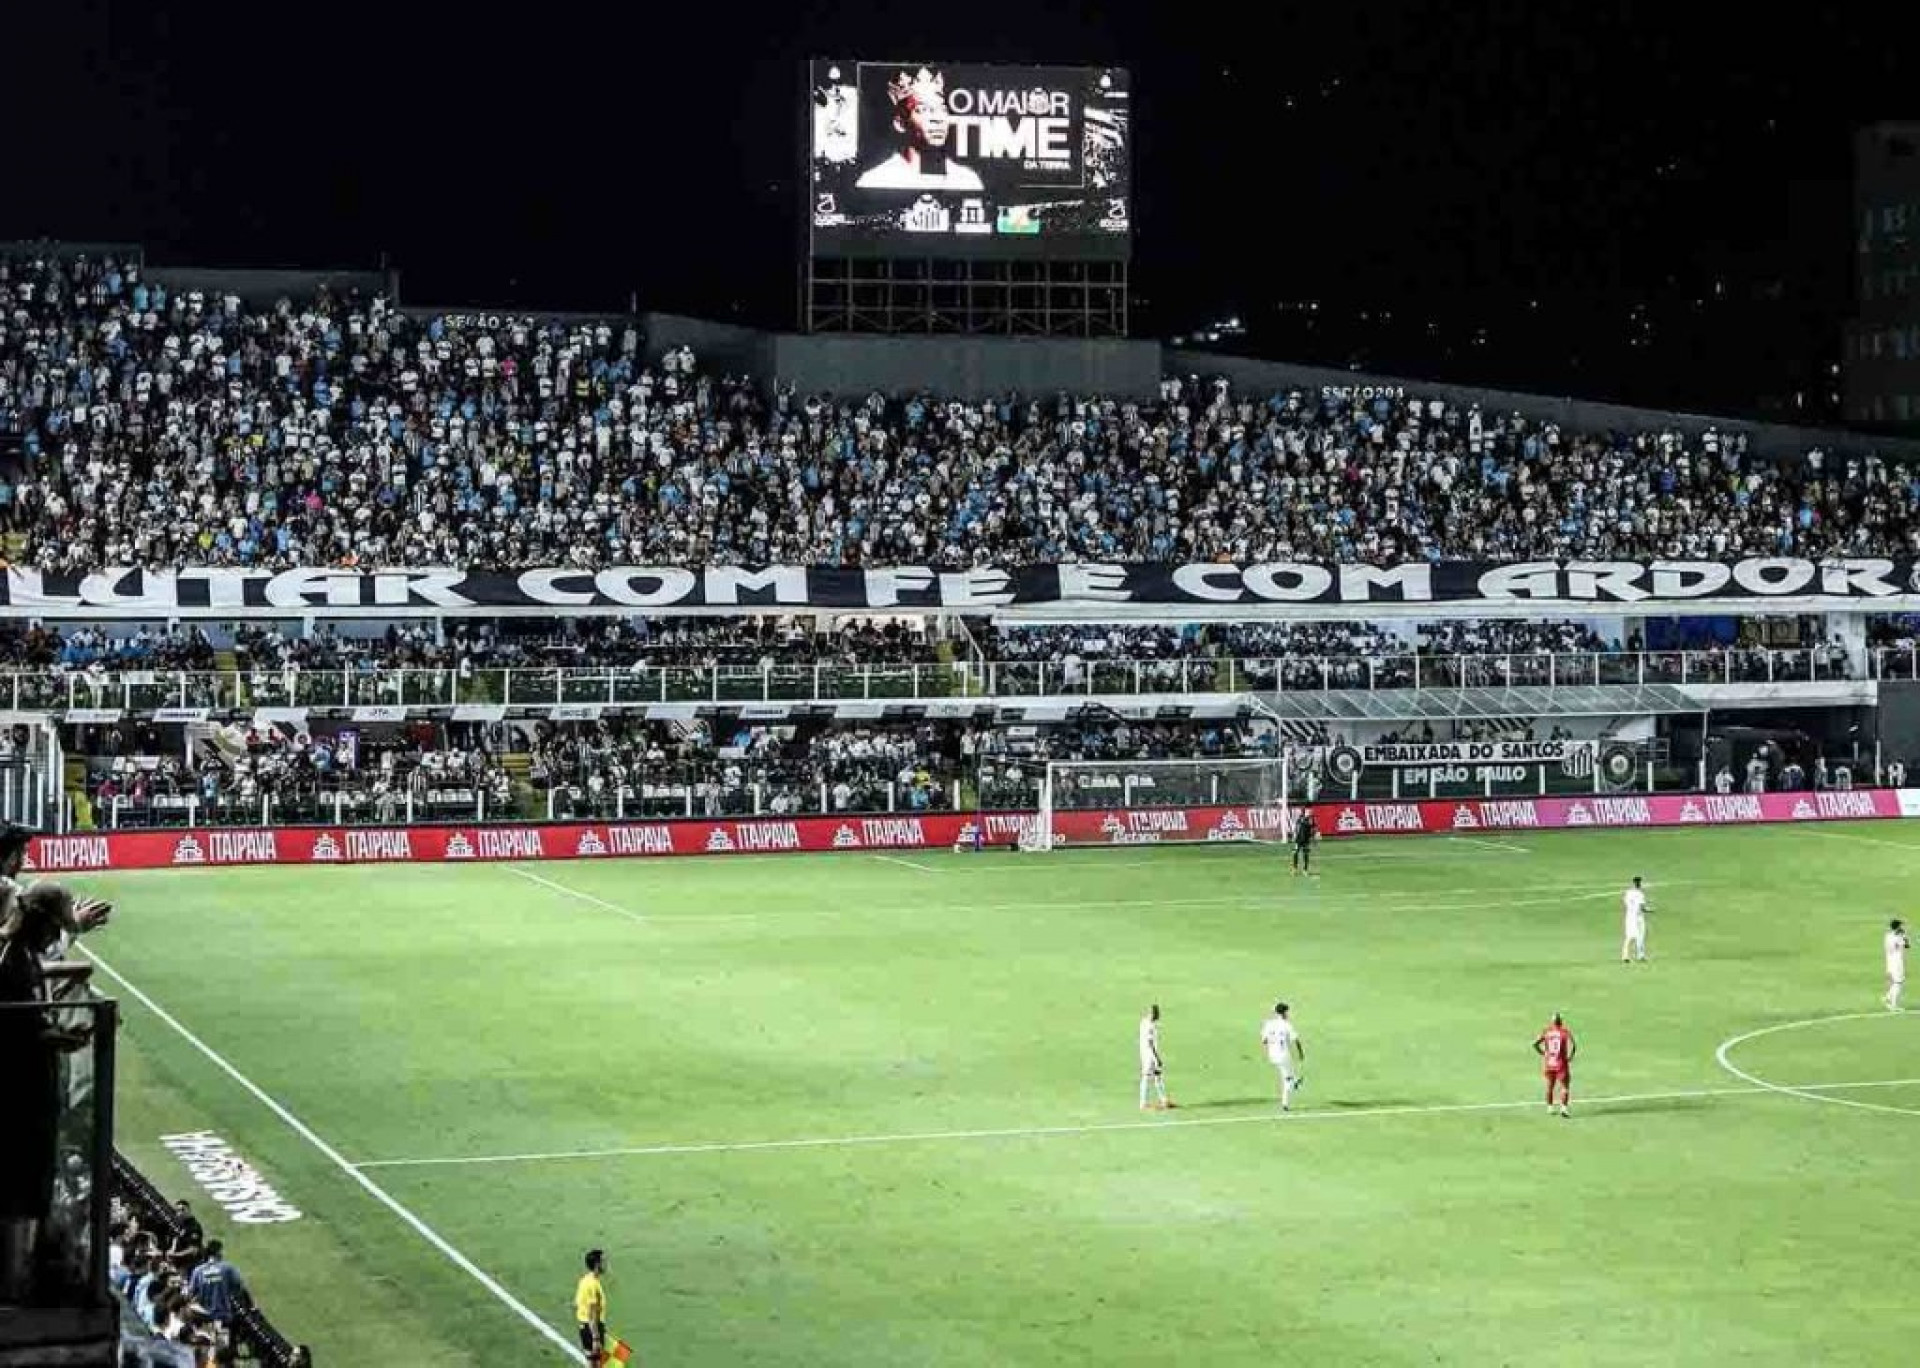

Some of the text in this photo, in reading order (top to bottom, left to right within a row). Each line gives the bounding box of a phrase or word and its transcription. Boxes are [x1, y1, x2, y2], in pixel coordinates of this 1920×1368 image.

[948, 88, 973, 114] O
[947, 115, 1071, 158] TIME
[517, 565, 809, 606] COM
[1057, 563, 1133, 600] E
[1172, 562, 1432, 601] COM
[1477, 558, 1902, 602] ARDOR
[1364, 740, 1565, 761] EMBAIXADA DO SANTOS
[1403, 768, 1429, 784] EM
[41, 838, 109, 867] ITAIPAVA
[209, 831, 277, 861] ITAIPAVA
[344, 831, 411, 860] ITAIPAVA
[478, 828, 543, 858] ITAIPAVA
[607, 826, 674, 854] ITAIPAVA
[735, 822, 801, 849] ITAIPAVA
[861, 818, 926, 846] ITAIPAVA
